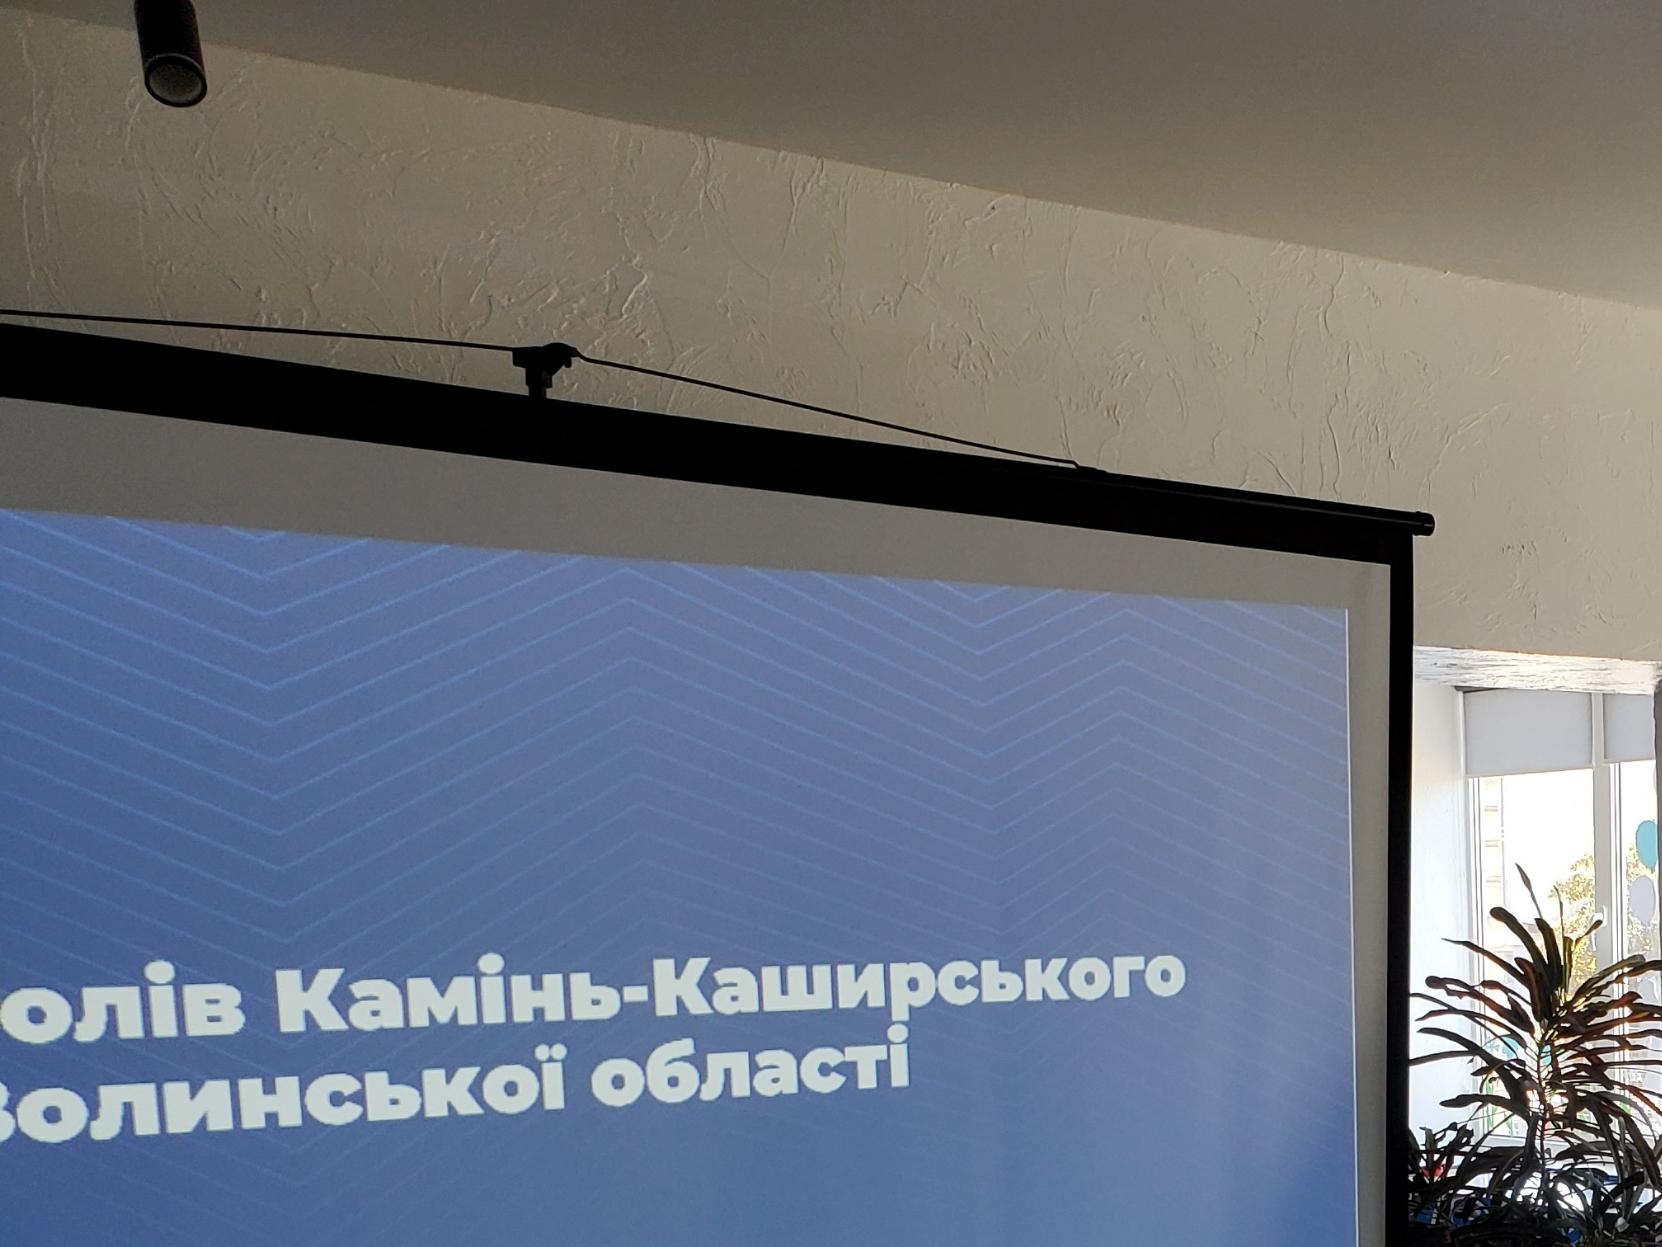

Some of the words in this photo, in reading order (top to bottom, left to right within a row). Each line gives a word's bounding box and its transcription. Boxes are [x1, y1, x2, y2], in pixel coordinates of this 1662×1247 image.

[0, 959, 246, 1044] олів
[273, 952, 1187, 1033] Камінь-Каширського
[0, 1043, 567, 1143] олинської
[591, 1022, 910, 1108] області
